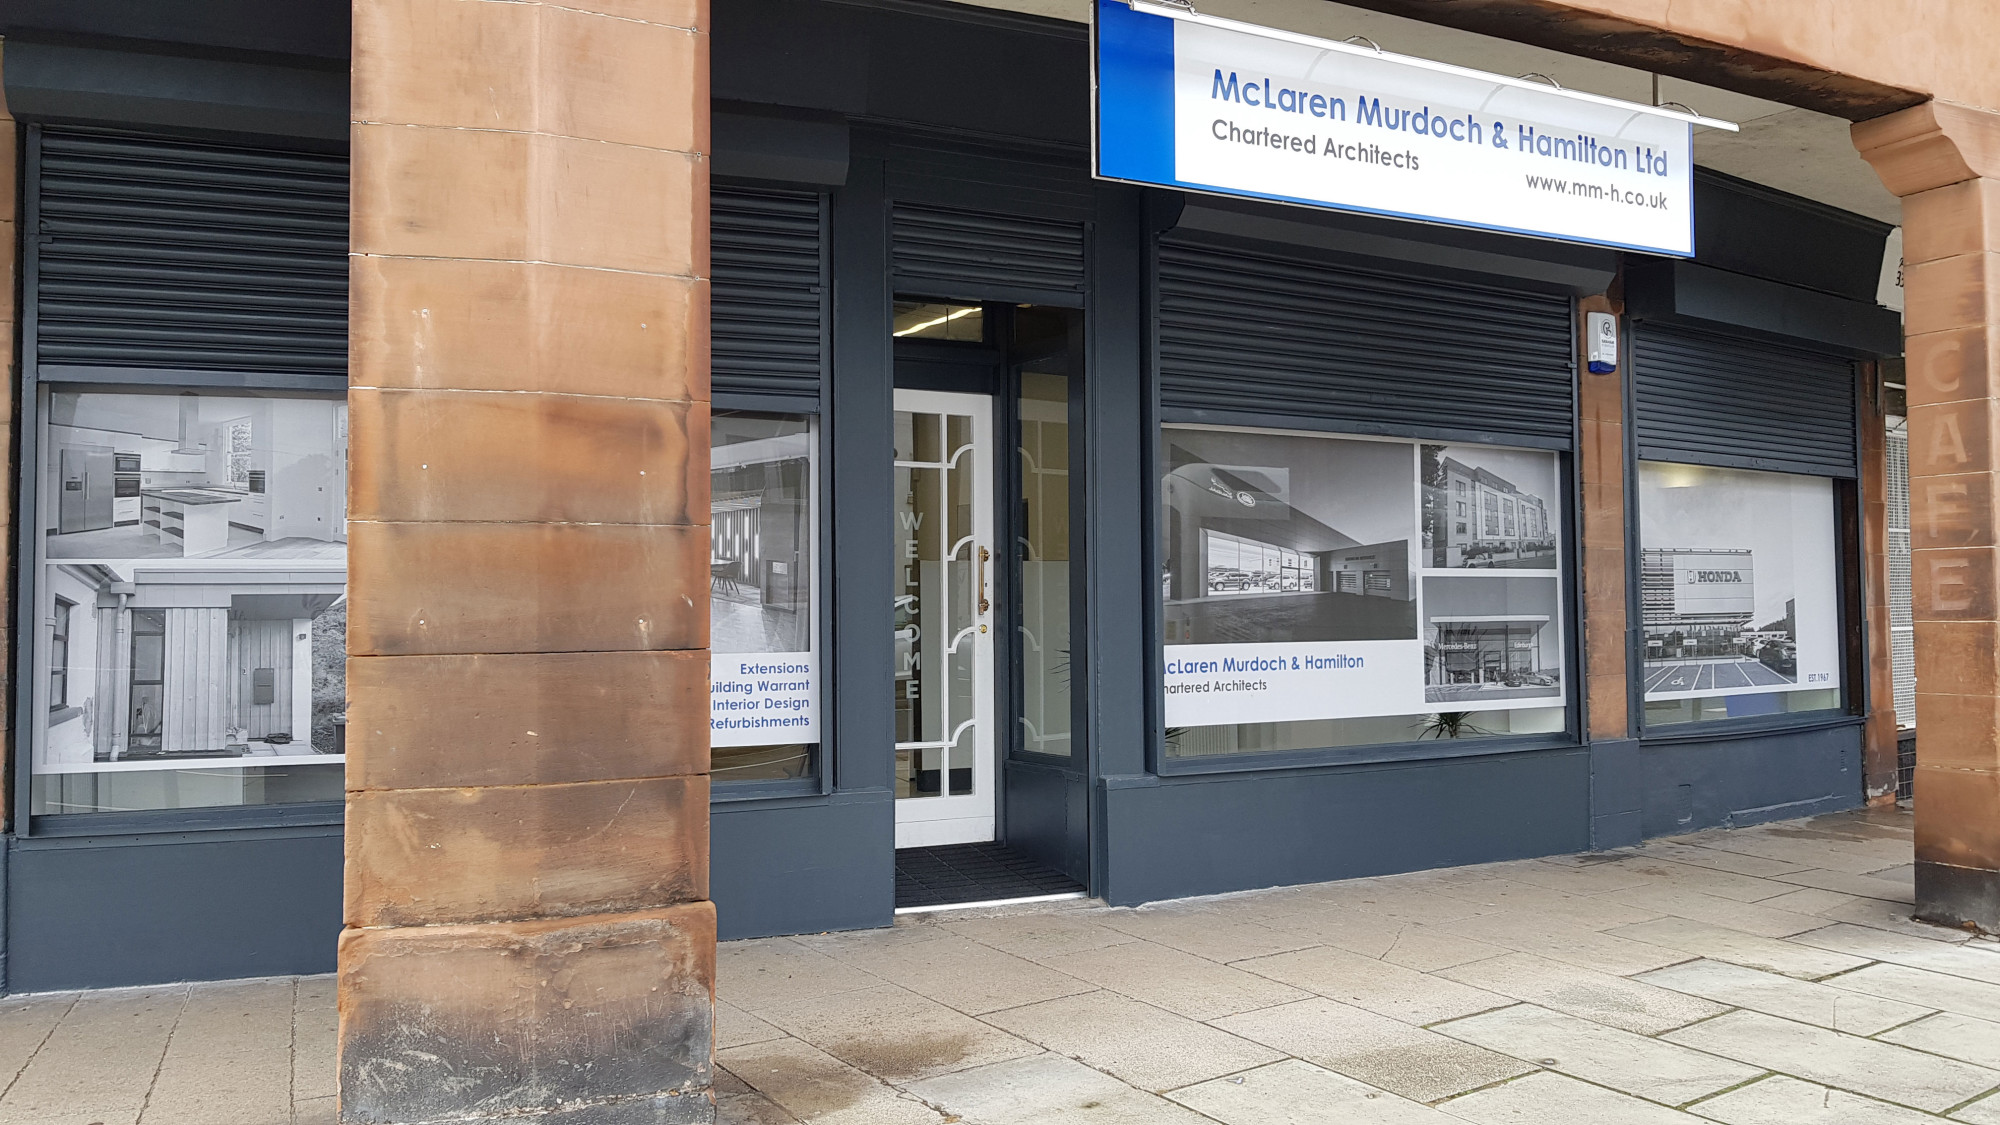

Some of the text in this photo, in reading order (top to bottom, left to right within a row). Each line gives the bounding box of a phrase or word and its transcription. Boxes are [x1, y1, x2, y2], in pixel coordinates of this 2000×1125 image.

[1211, 68, 1668, 177] McLaren Murdoch & Hamilton Ltd
[1211, 118, 1420, 171] Chartered Architects
[1525, 174, 1668, 210] www.mm-h.co.uk
[1697, 570, 1742, 583] HONDA
[899, 511, 924, 699] WELCOME
[740, 662, 809, 675] Extensions
[1222, 656, 1287, 673] Murdoch
[1291, 656, 1301, 671] &
[1305, 654, 1364, 670] Hamilton
[711, 679, 810, 695] uilding Warrant
[1213, 679, 1268, 693] Architects
[713, 697, 809, 711] Interior Design
